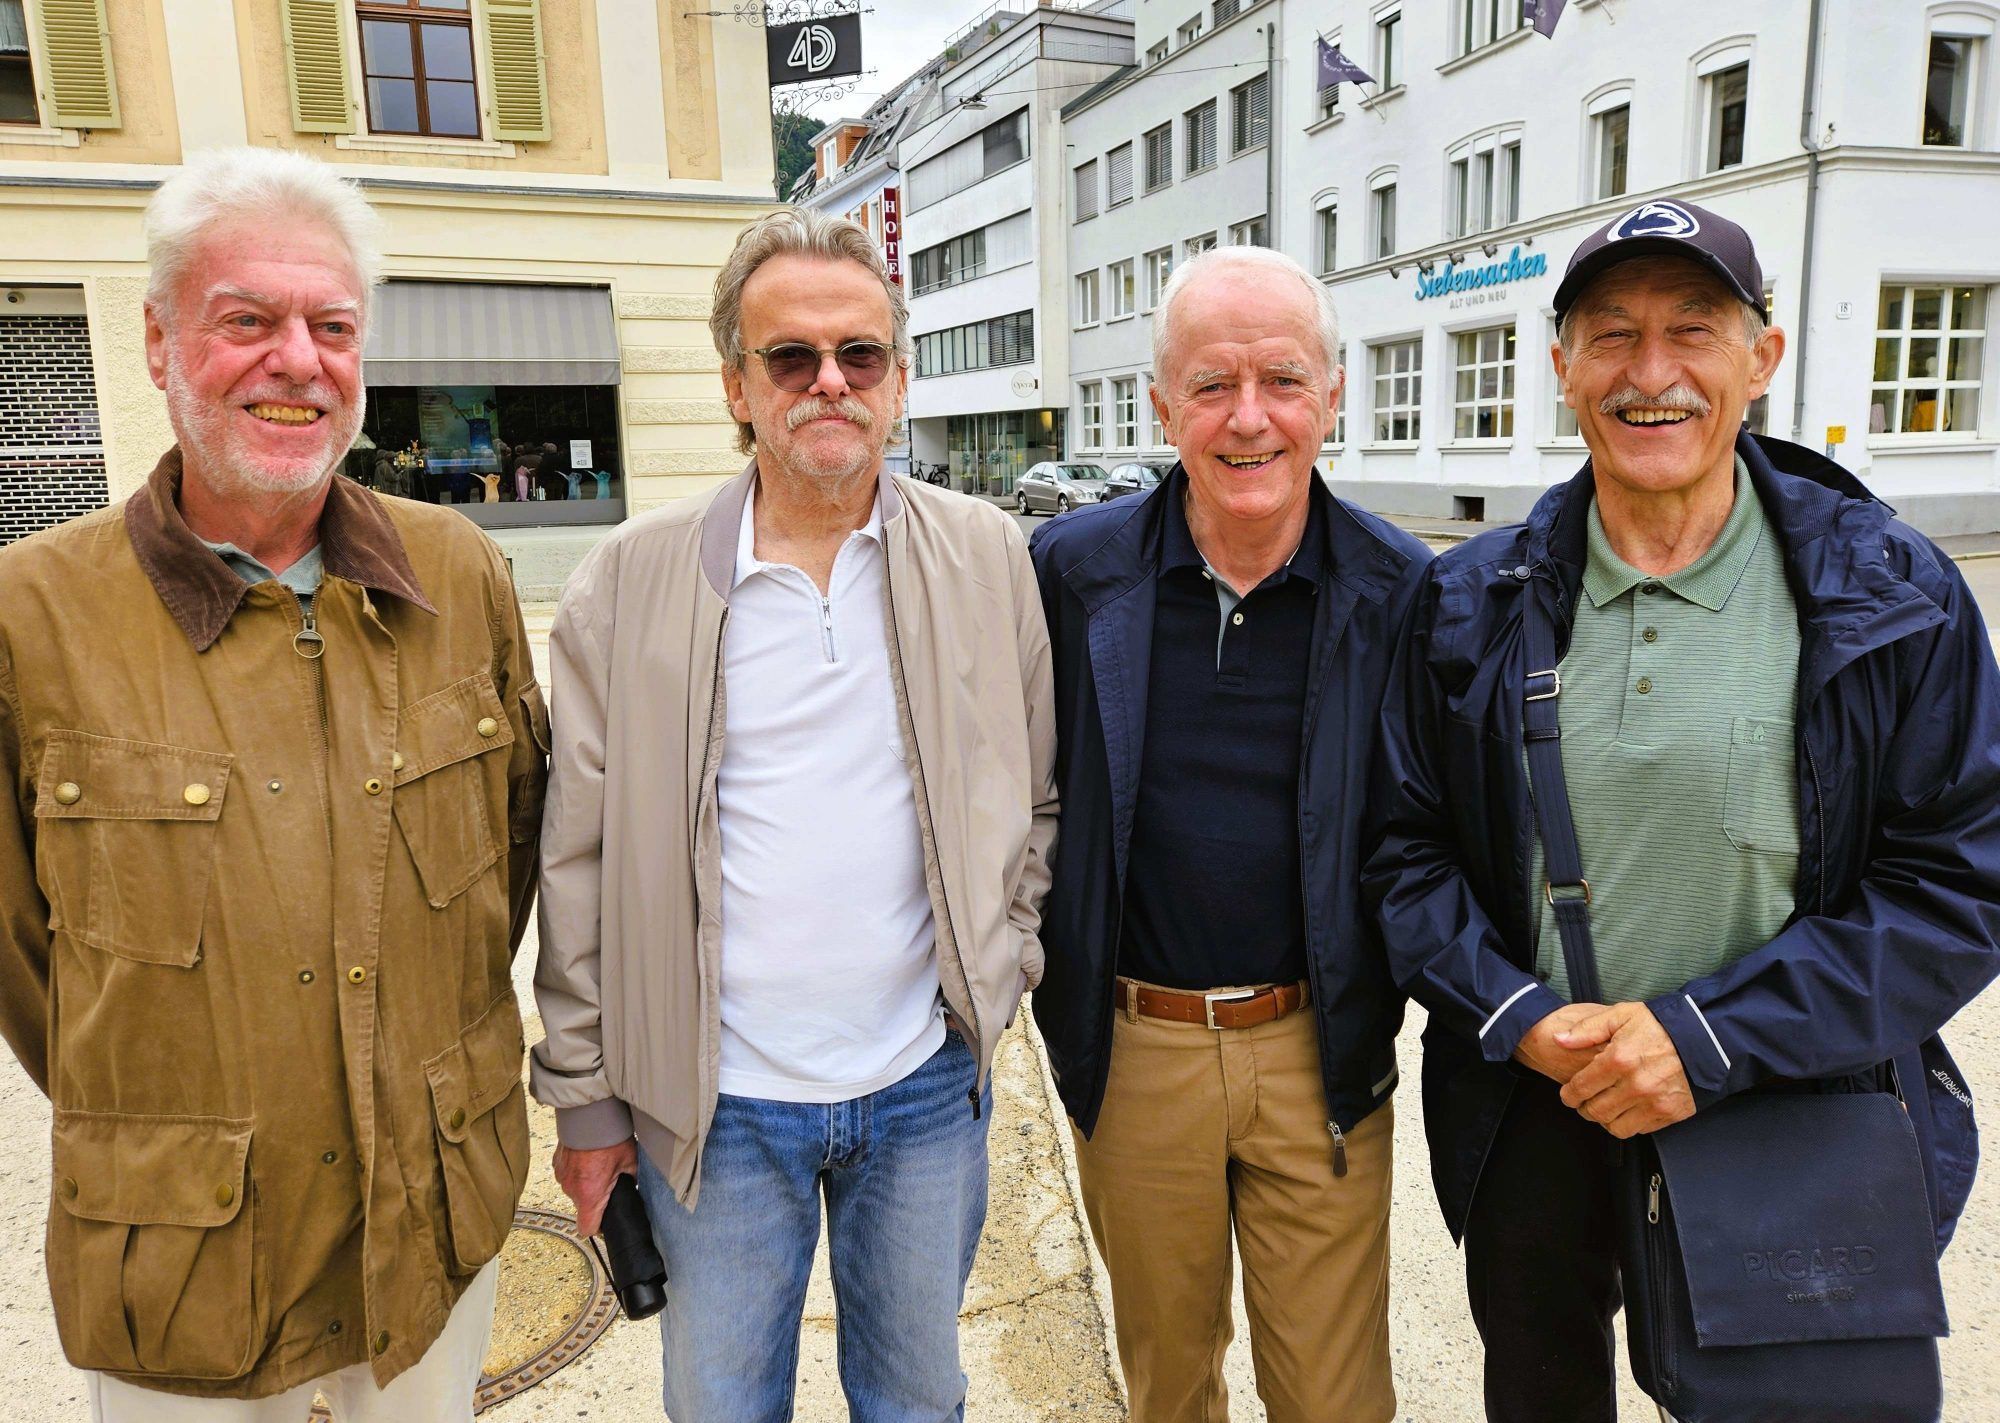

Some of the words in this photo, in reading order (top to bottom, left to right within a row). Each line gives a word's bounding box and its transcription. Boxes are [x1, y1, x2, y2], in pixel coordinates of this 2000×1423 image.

[884, 201, 899, 275] HOTE
[1415, 246, 1547, 300] Siebensachen
[1449, 298, 1463, 310] ALT
[1466, 293, 1485, 307] UND
[1488, 290, 1506, 303] NEU
[1743, 1246, 1879, 1281] PICARD
[1787, 1290, 1822, 1303] since
